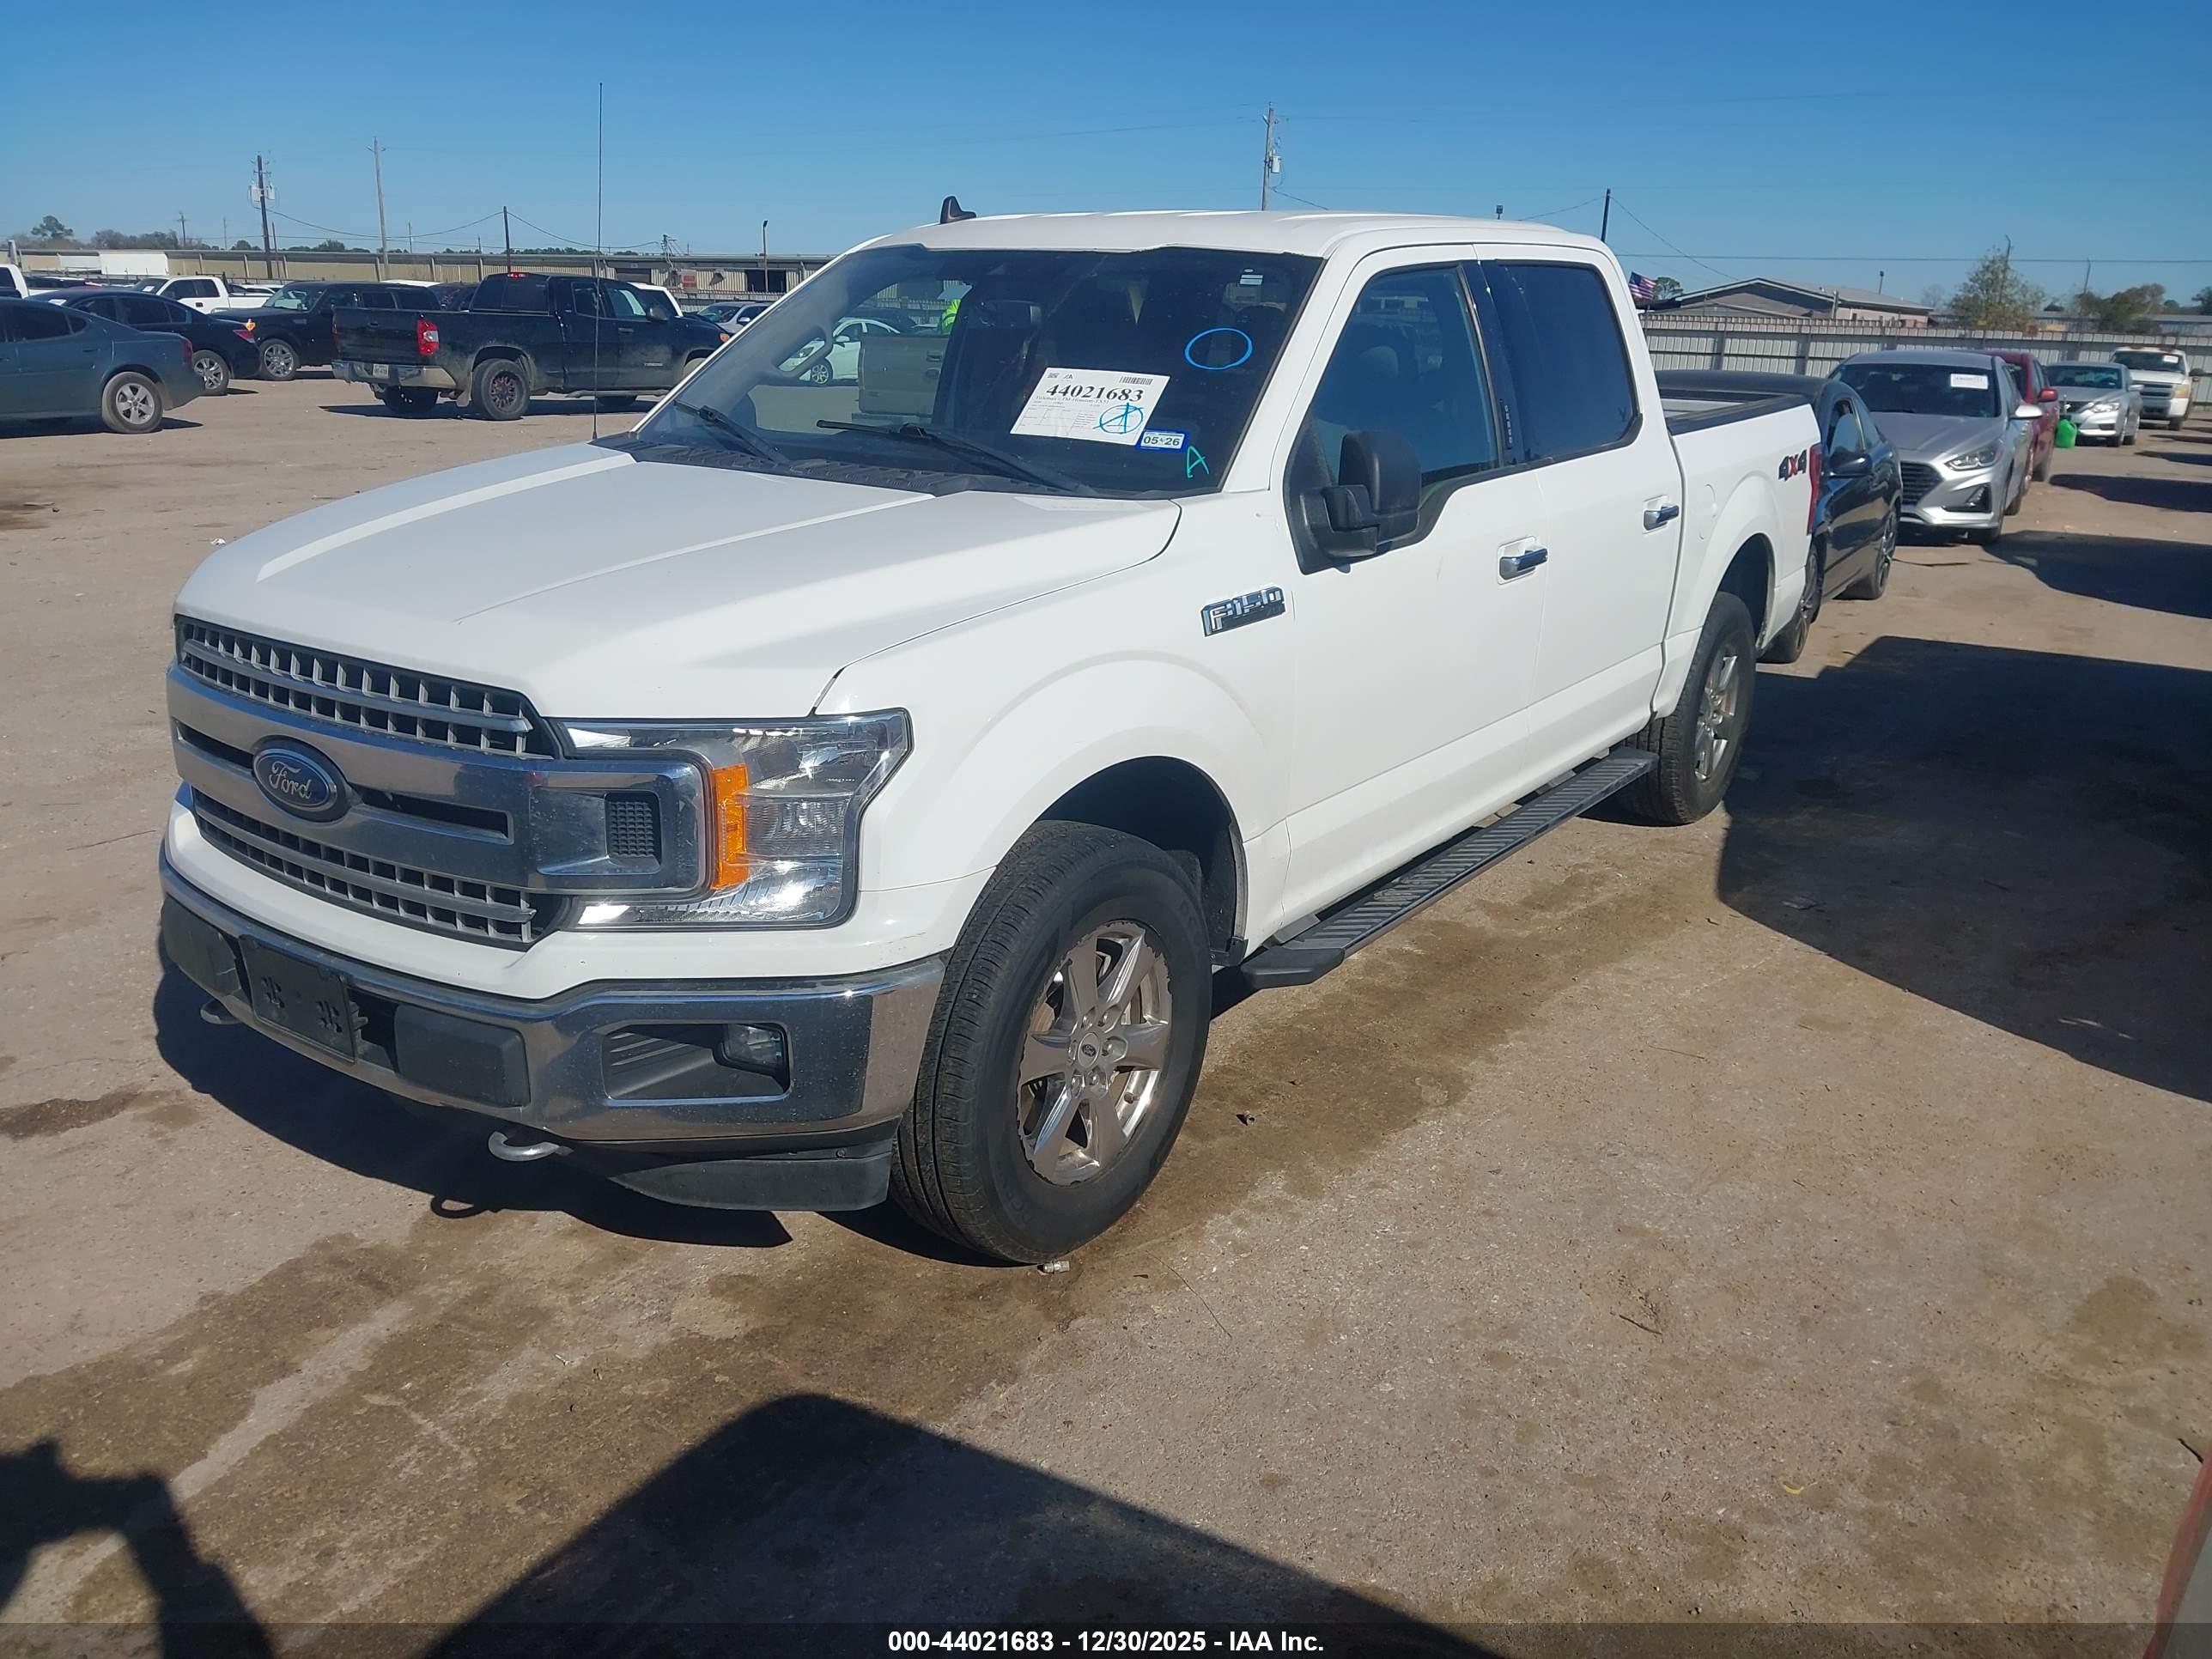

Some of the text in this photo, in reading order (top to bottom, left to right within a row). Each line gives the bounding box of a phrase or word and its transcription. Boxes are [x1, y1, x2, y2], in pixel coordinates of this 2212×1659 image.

[1046, 383, 1144, 402] 44021683
[1143, 436, 1180, 447] 05 26
[269, 761, 312, 799] Ford
